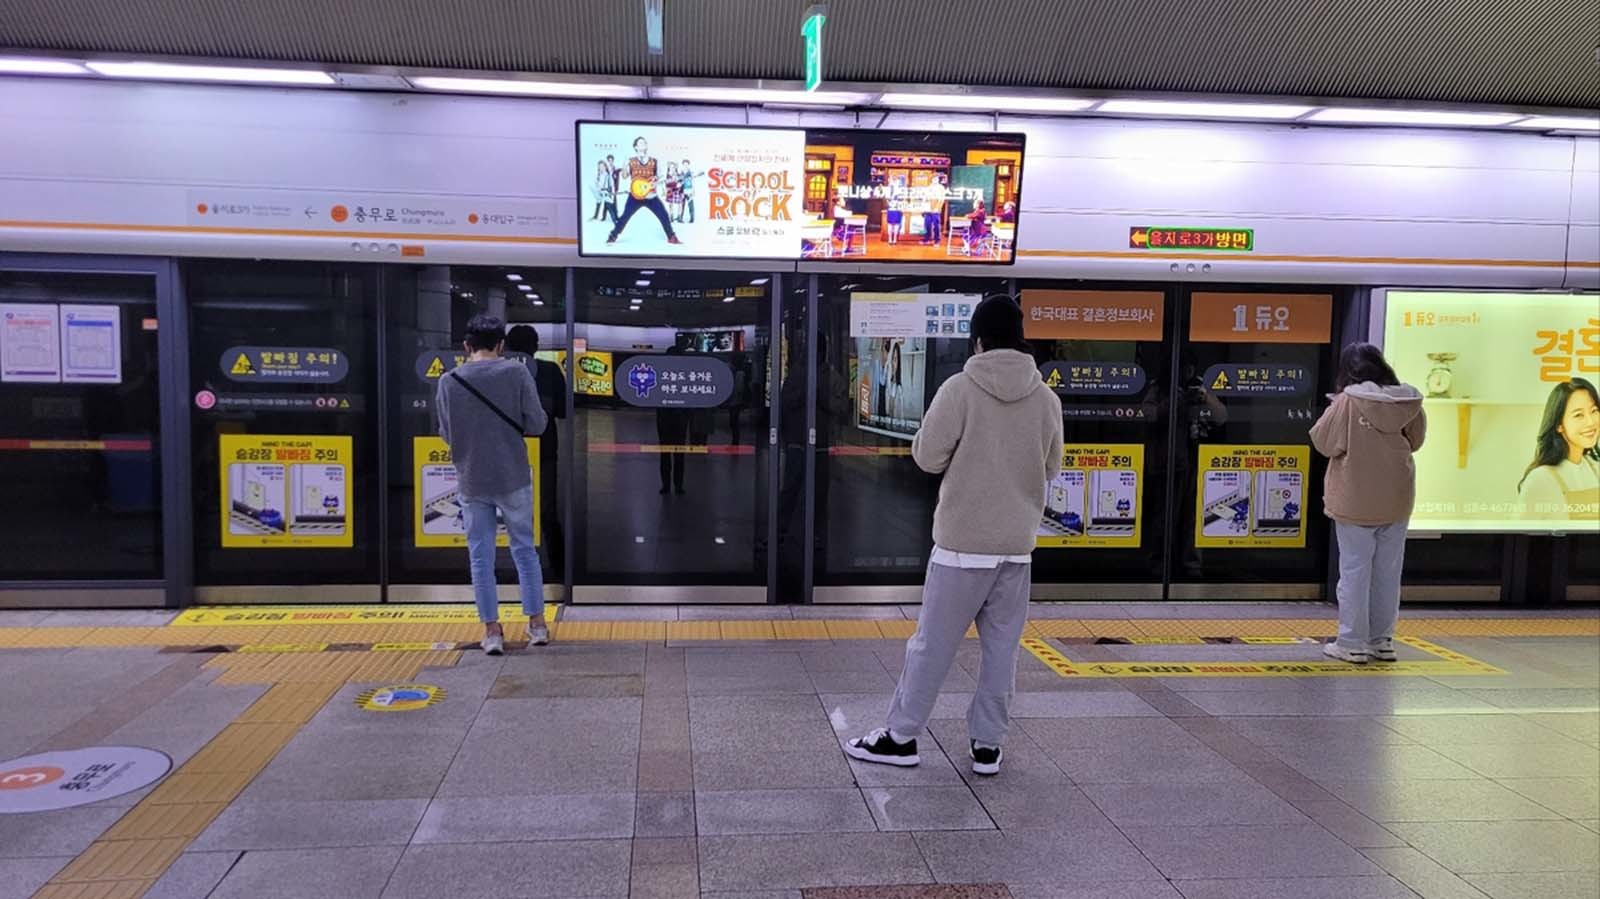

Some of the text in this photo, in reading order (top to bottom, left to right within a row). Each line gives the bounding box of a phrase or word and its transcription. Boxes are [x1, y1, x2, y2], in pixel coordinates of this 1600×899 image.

[707, 168, 796, 190] SCHOOL
[709, 192, 793, 221] ROCK
[353, 206, 399, 223] 충무로
[1215, 231, 1248, 250] 방면
[1030, 305, 1154, 323] 한국대표 결혼정보회사
[1232, 304, 1289, 331] 1 듀오
[1416, 312, 1435, 326] 듀오
[261, 352, 338, 366] 발빠짐 주의!
[661, 371, 713, 382] 오늘도 즐거운
[1071, 366, 1103, 378] 발빠짐
[1237, 368, 1303, 380] 발빠짐 주의!
[661, 384, 717, 395] 하루 보내세요!
[413, 399, 427, 408] 6-3
[236, 448, 338, 461] 승강장 발빠짐 주의
[1078, 456, 1109, 467] 발빠짐
[1111, 456, 1131, 468] 주의
[1211, 456, 1298, 469] 승강장 발빠짐 주의
[2, 772, 48, 784] 3
